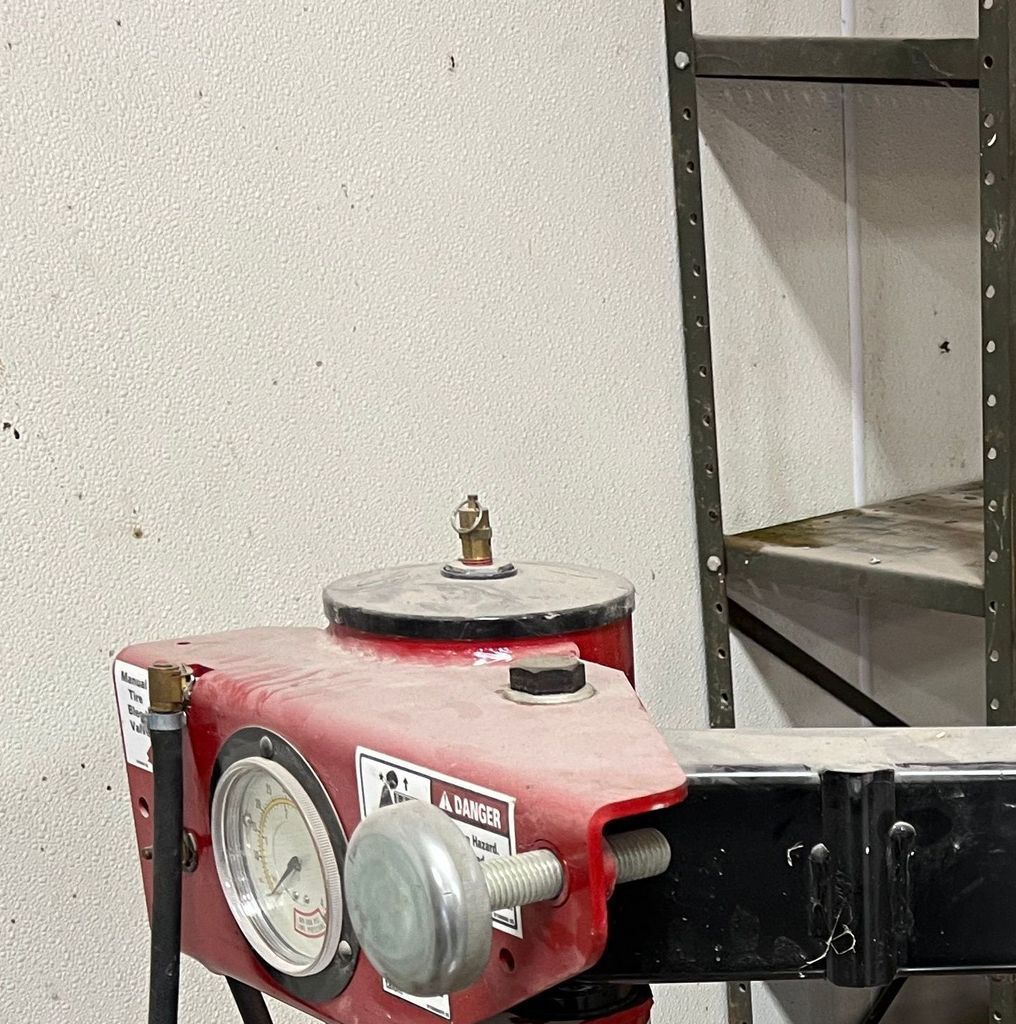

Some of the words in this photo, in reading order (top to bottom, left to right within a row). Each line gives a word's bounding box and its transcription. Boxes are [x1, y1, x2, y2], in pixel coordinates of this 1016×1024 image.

[121, 671, 147, 690] Manual
[128, 689, 143, 704] Tire
[454, 794, 501, 829] DANGER
